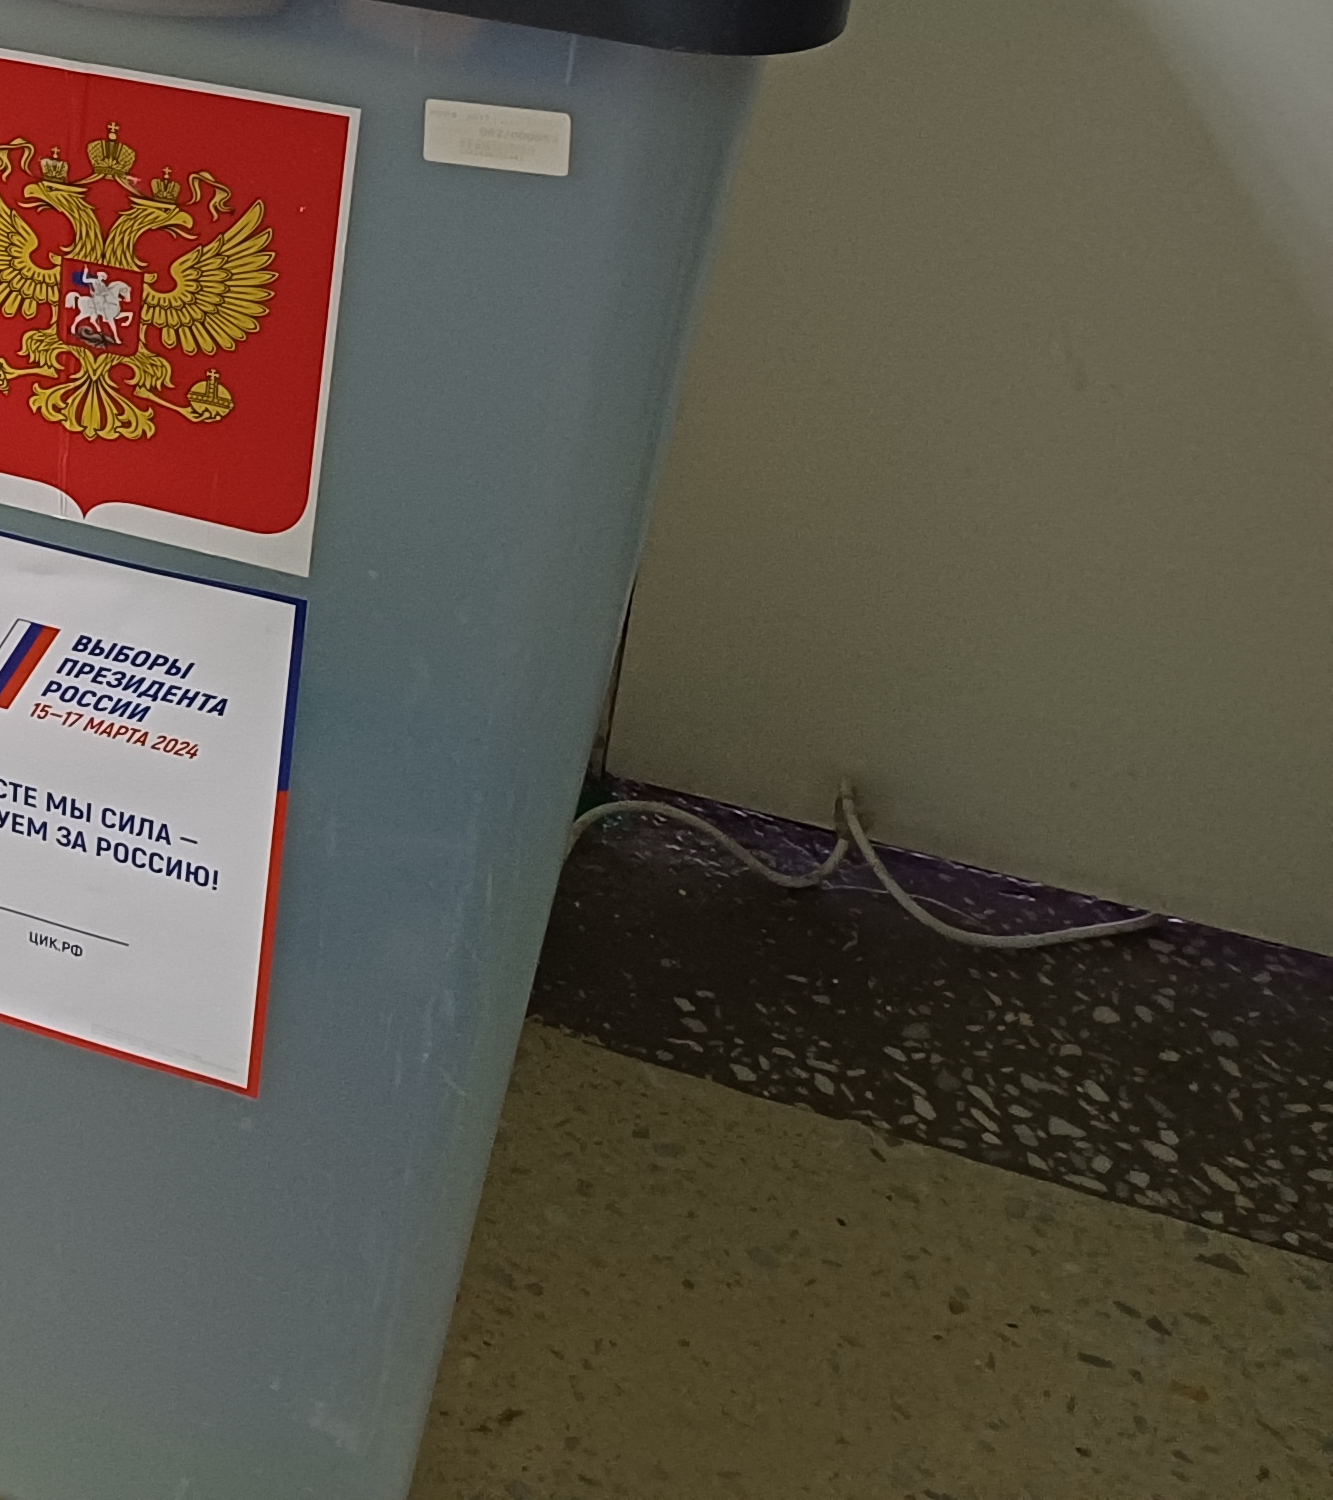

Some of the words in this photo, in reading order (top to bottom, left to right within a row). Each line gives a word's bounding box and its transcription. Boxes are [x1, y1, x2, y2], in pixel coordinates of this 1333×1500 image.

[71, 634, 195, 680] ВЫБОРЫ
[40, 680, 152, 723] РОССИИ
[55, 657, 229, 717] ПРЕЗИДЕНТА
[82, 716, 150, 747] МАРТА
[150, 735, 200, 760] 2024
[46, 791, 92, 823] МЫ
[101, 807, 172, 846] СИЛА
[55, 825, 87, 853] ЗА
[95, 836, 219, 891] РОССИЮ!
[28, 930, 83, 958] ЦИК.РФ
